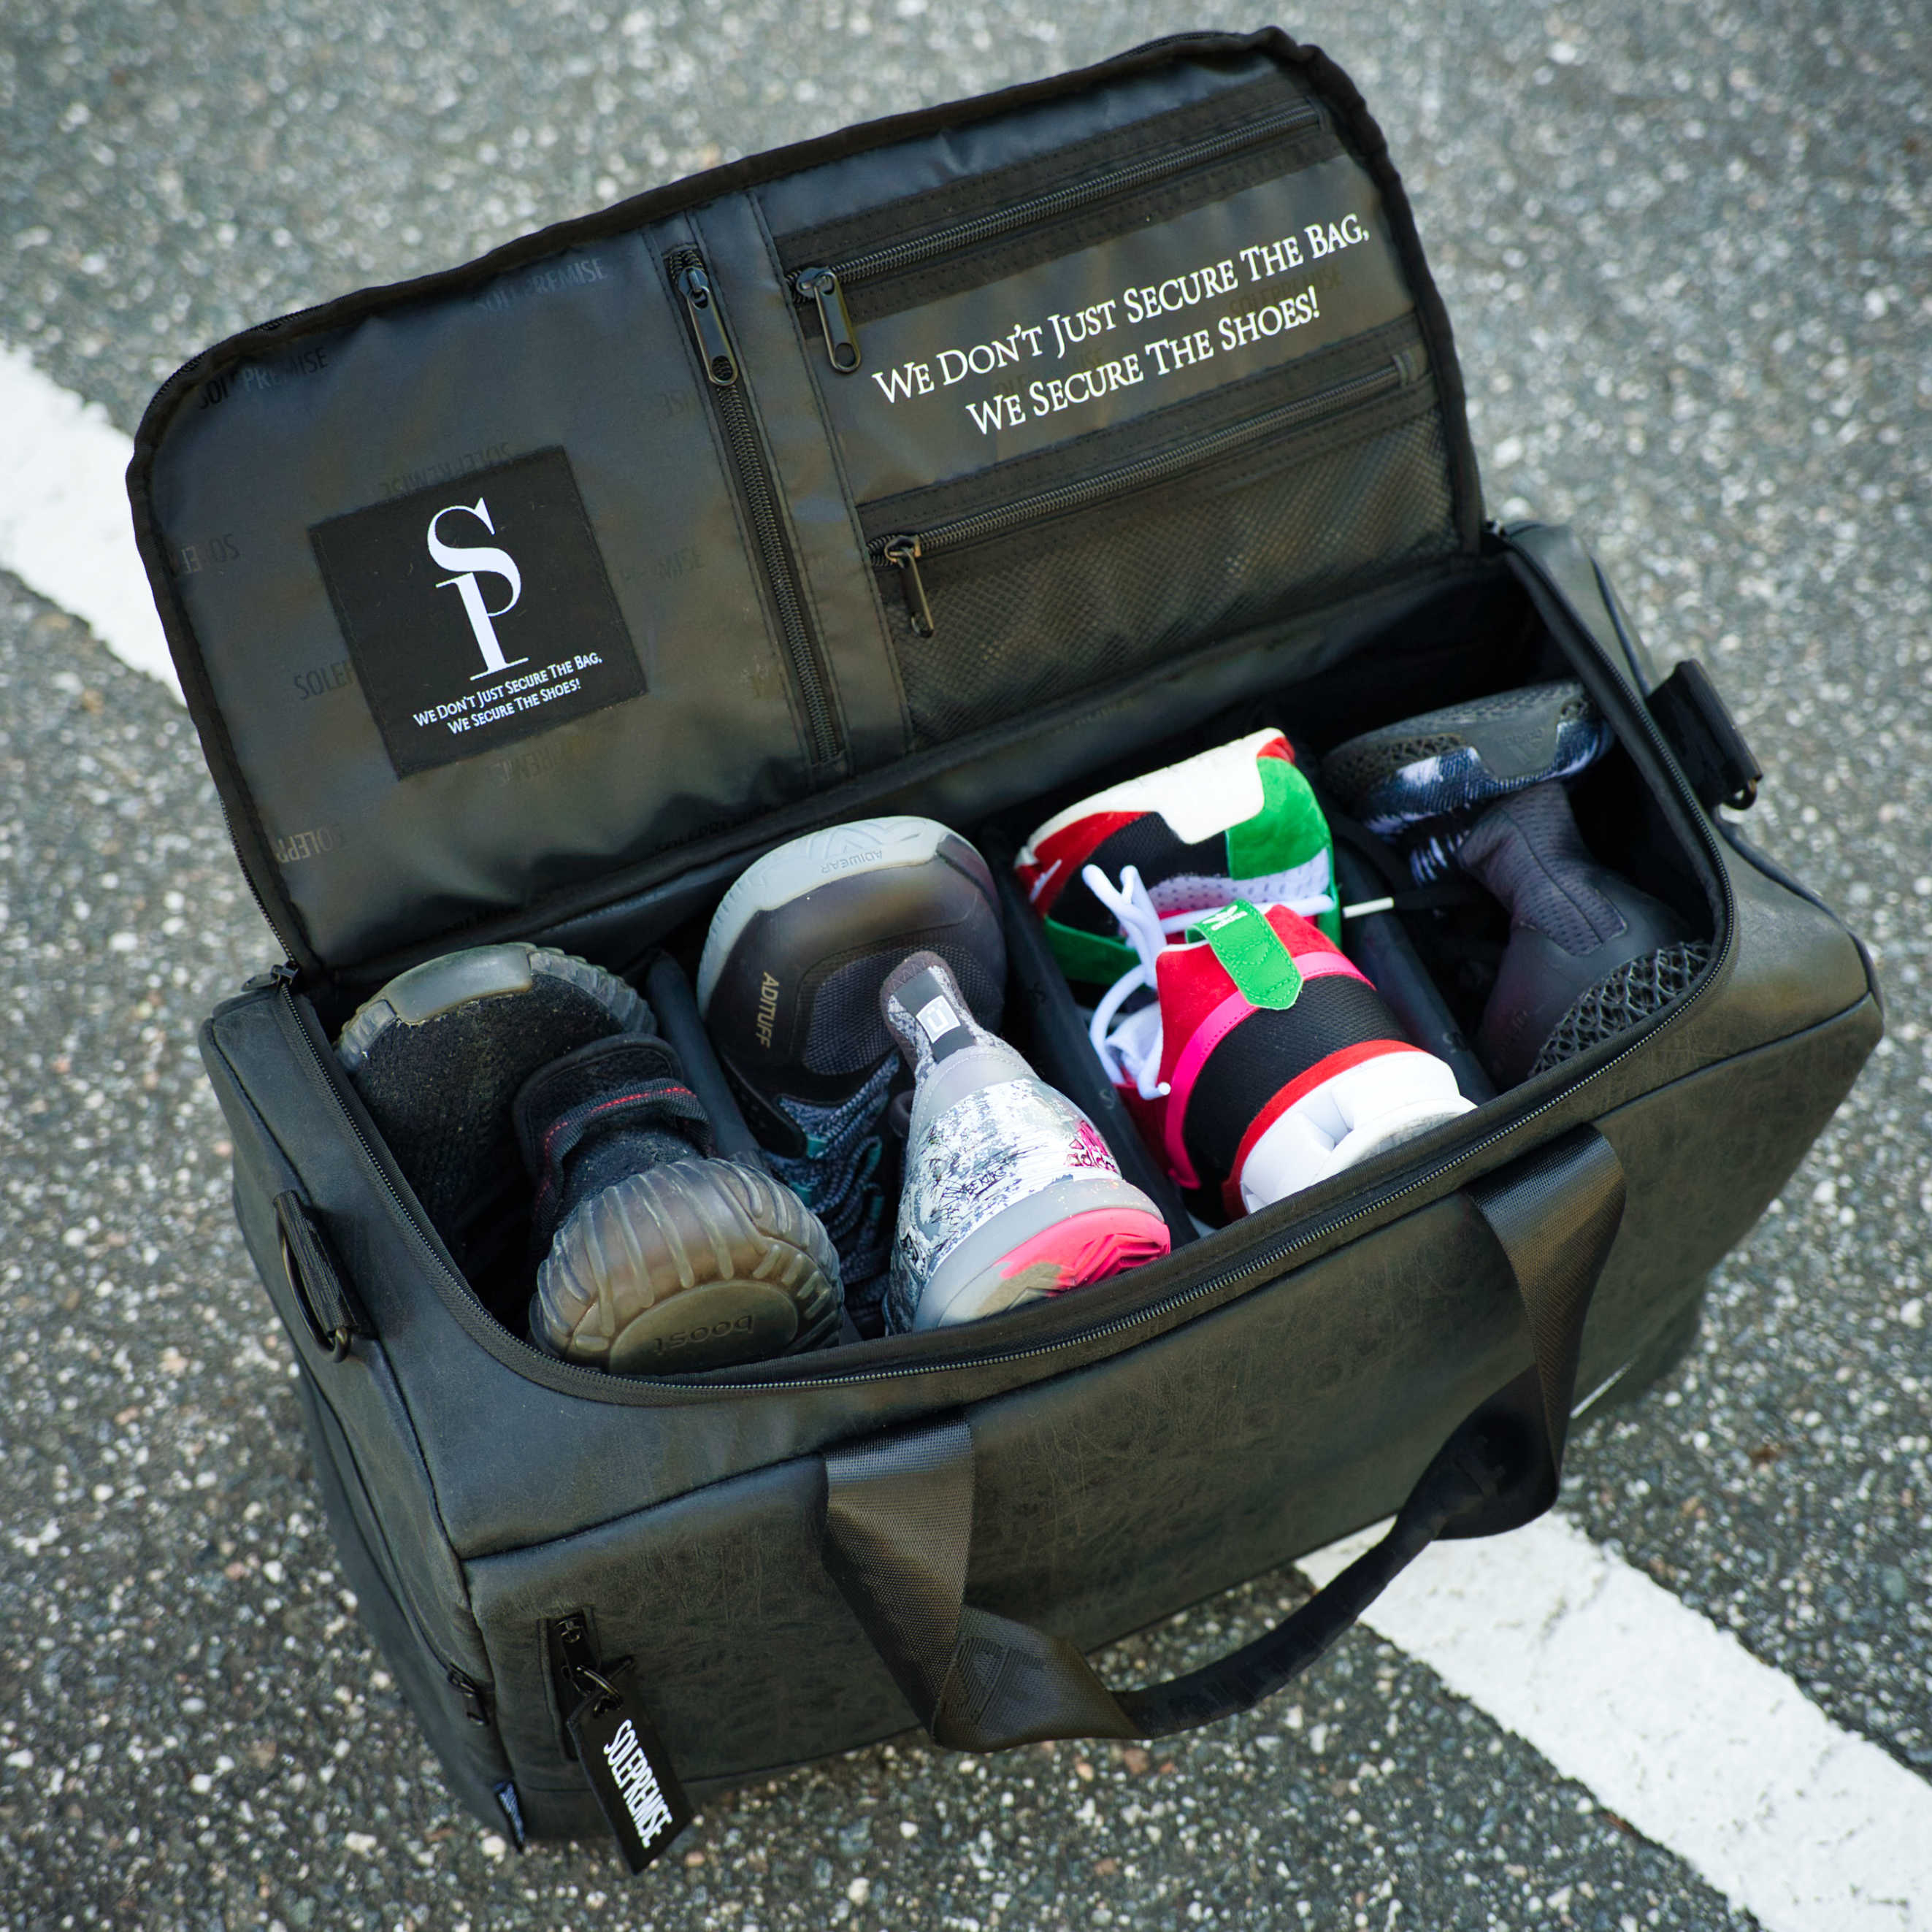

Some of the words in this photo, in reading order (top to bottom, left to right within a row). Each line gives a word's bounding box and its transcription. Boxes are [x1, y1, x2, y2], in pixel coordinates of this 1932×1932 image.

[871, 361, 935, 404] WE
[1047, 299, 1116, 359] JUST
[1123, 259, 1238, 323] SECURE
[1239, 236, 1304, 282] THE
[1303, 213, 1370, 259] BAG,
[965, 394, 1027, 435] WE
[1029, 353, 1144, 416] SECURE
[1144, 329, 1214, 375] THE
[1218, 285, 1320, 351] SHOES!
[413, 709, 437, 727] WE
[476, 685, 505, 710] JUST
[504, 670, 549, 695] SECURE
[546, 660, 575, 678] THE
[446, 717, 472, 735] WE
[470, 702, 515, 727] SECURE
[513, 692, 542, 711] THE
[539, 678, 581, 703] SHOES!
[819, 849, 883, 874] ADIWEAR
[754, 970, 781, 1049] ADITUFF
[653, 1314, 754, 1356] boost
[603, 1719, 673, 1849] SOLEPREMISE
